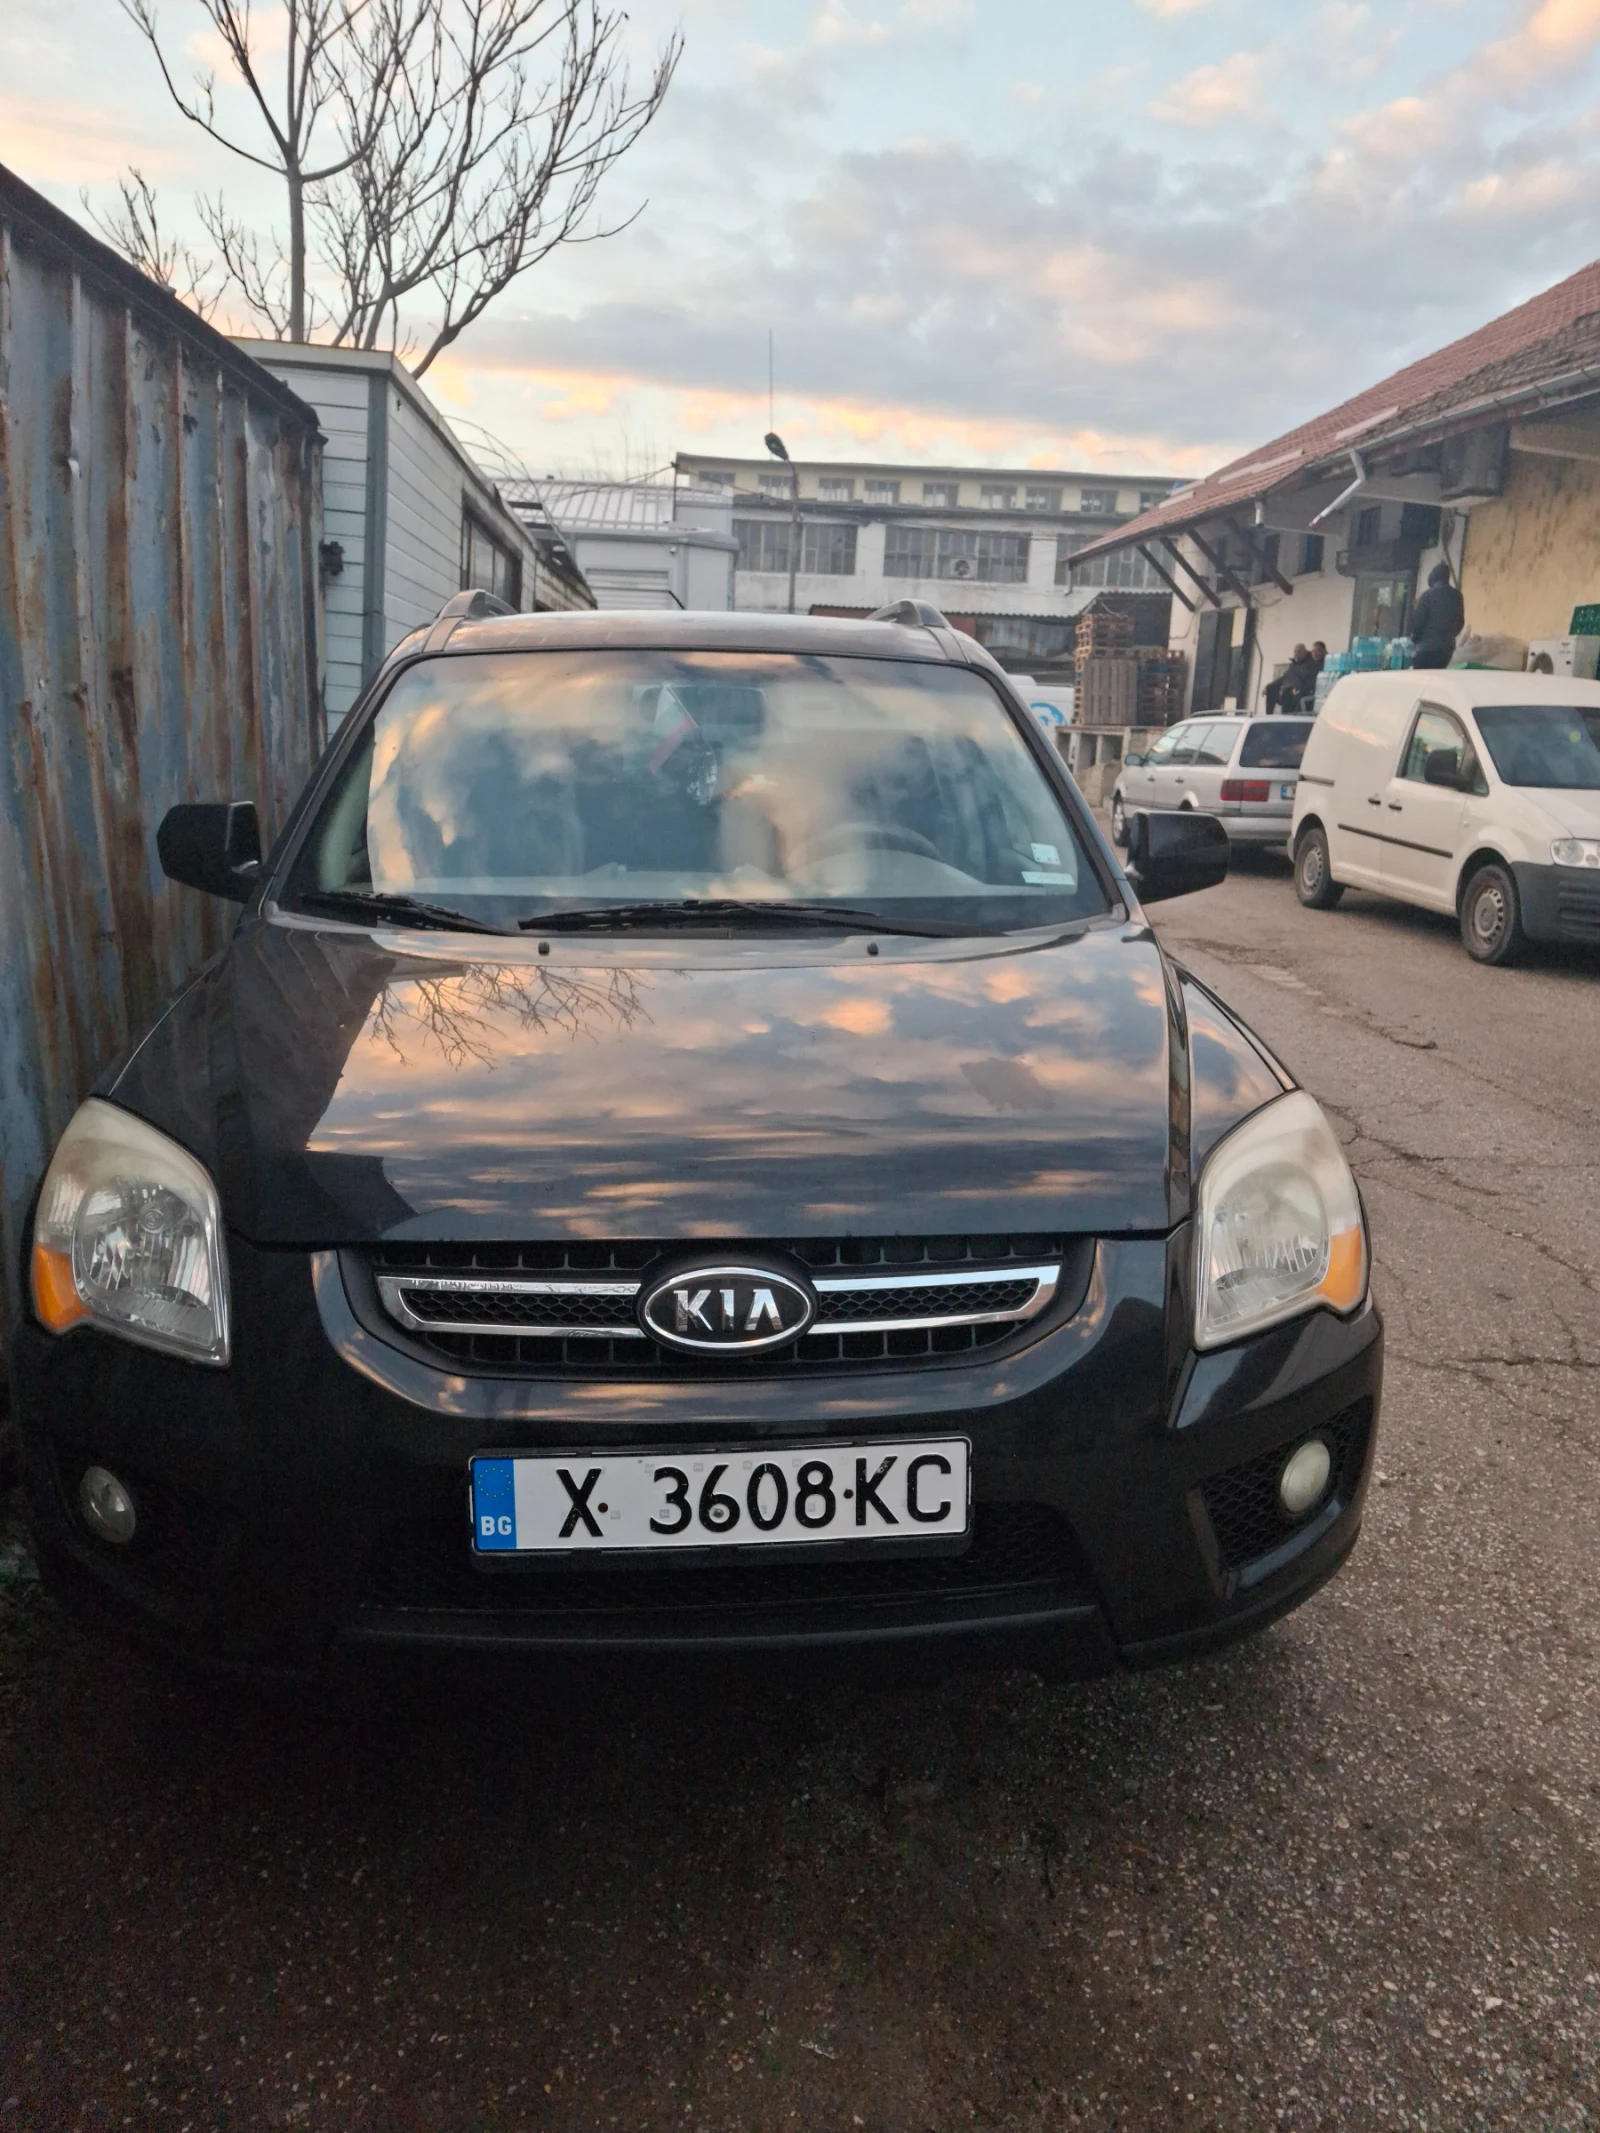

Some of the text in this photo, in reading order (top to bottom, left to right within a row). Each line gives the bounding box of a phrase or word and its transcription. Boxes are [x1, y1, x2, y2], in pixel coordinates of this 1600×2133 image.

[673, 1289, 784, 1332] KIA
[556, 1453, 951, 1538] X 3608 KC
[480, 1515, 512, 1536] BG
